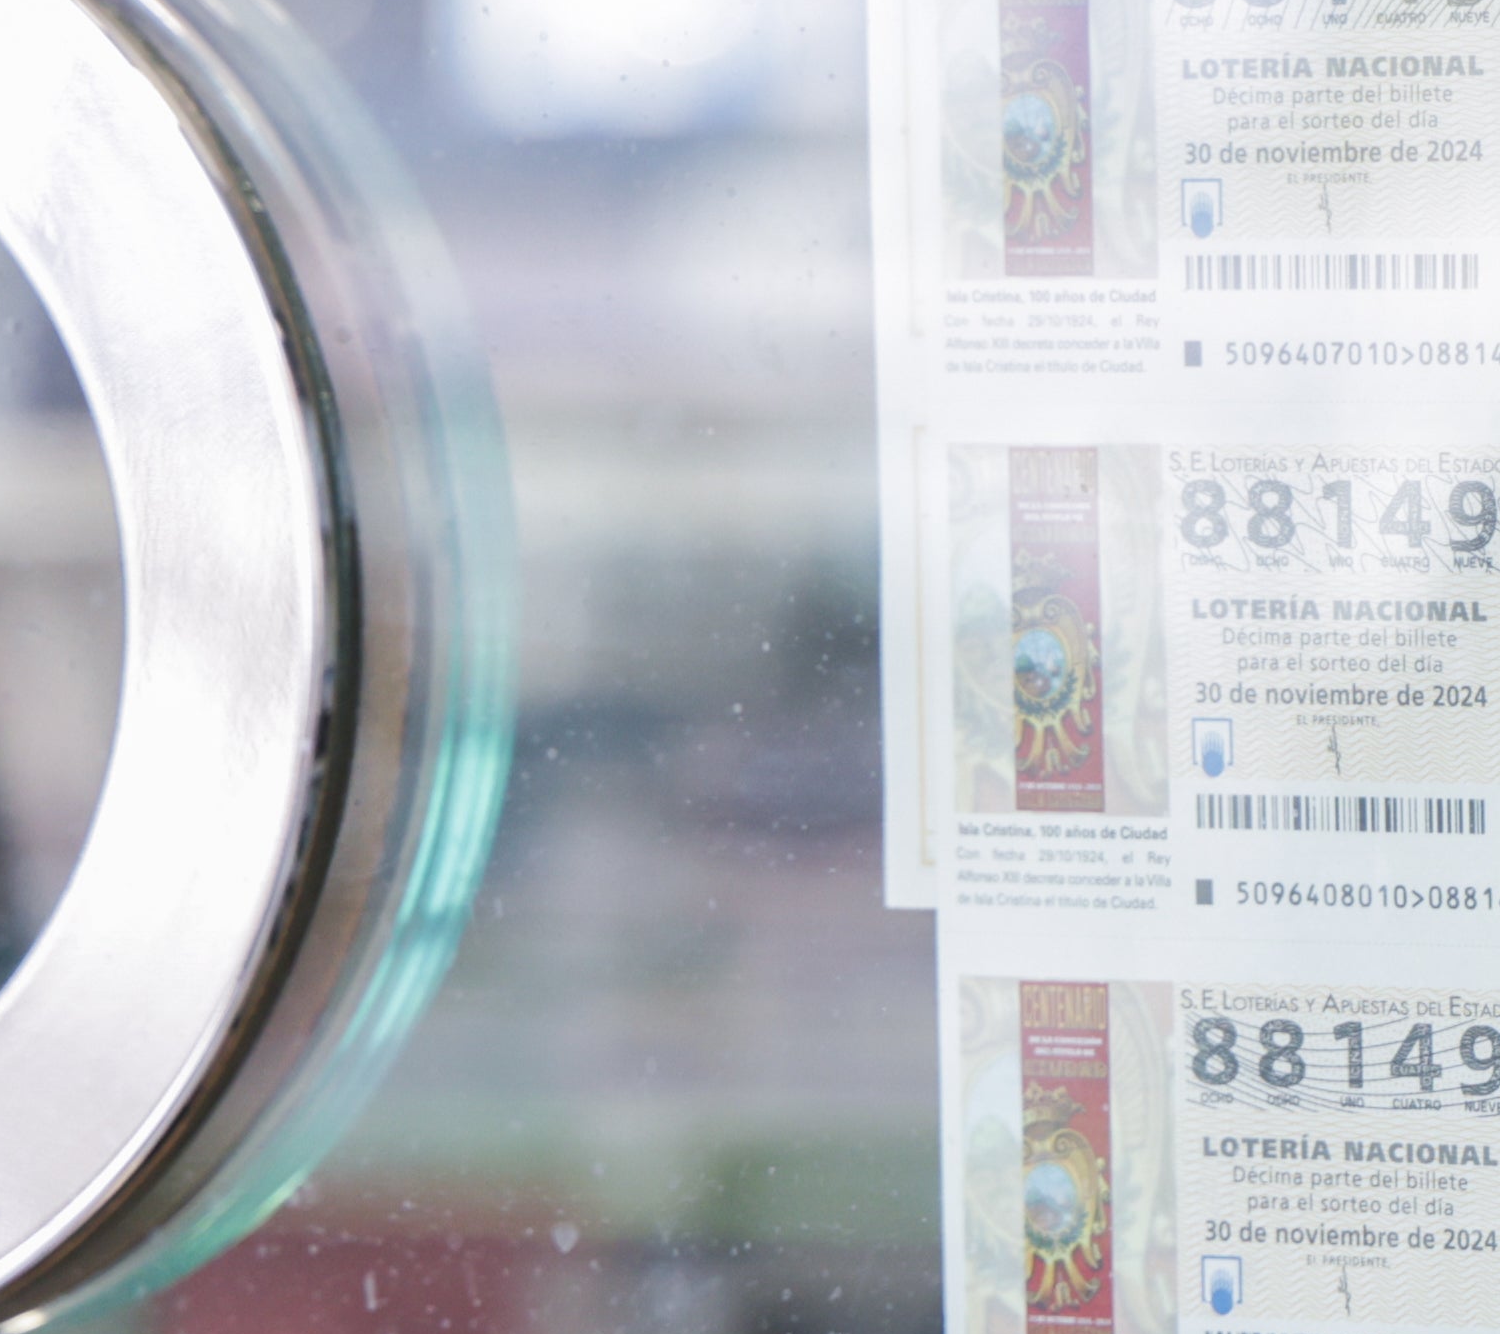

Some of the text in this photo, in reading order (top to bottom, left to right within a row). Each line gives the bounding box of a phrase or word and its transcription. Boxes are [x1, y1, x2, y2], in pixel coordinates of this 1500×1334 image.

[1181, 55, 1484, 80] LOTERÍA NACIONAL
[1185, 139, 1483, 165] 30 de noviembre de 2024
[1192, 598, 1487, 622] LOTERÍA NACIONAL
[1202, 1136, 1498, 1166] LOTERÍA NACIONAL
[1232, 1165, 1468, 1191] Décima parte del billete
[1247, 1193, 1454, 1216] para el sorteo del día
[1205, 1219, 1498, 1251] 30 de noviembre de 2024
